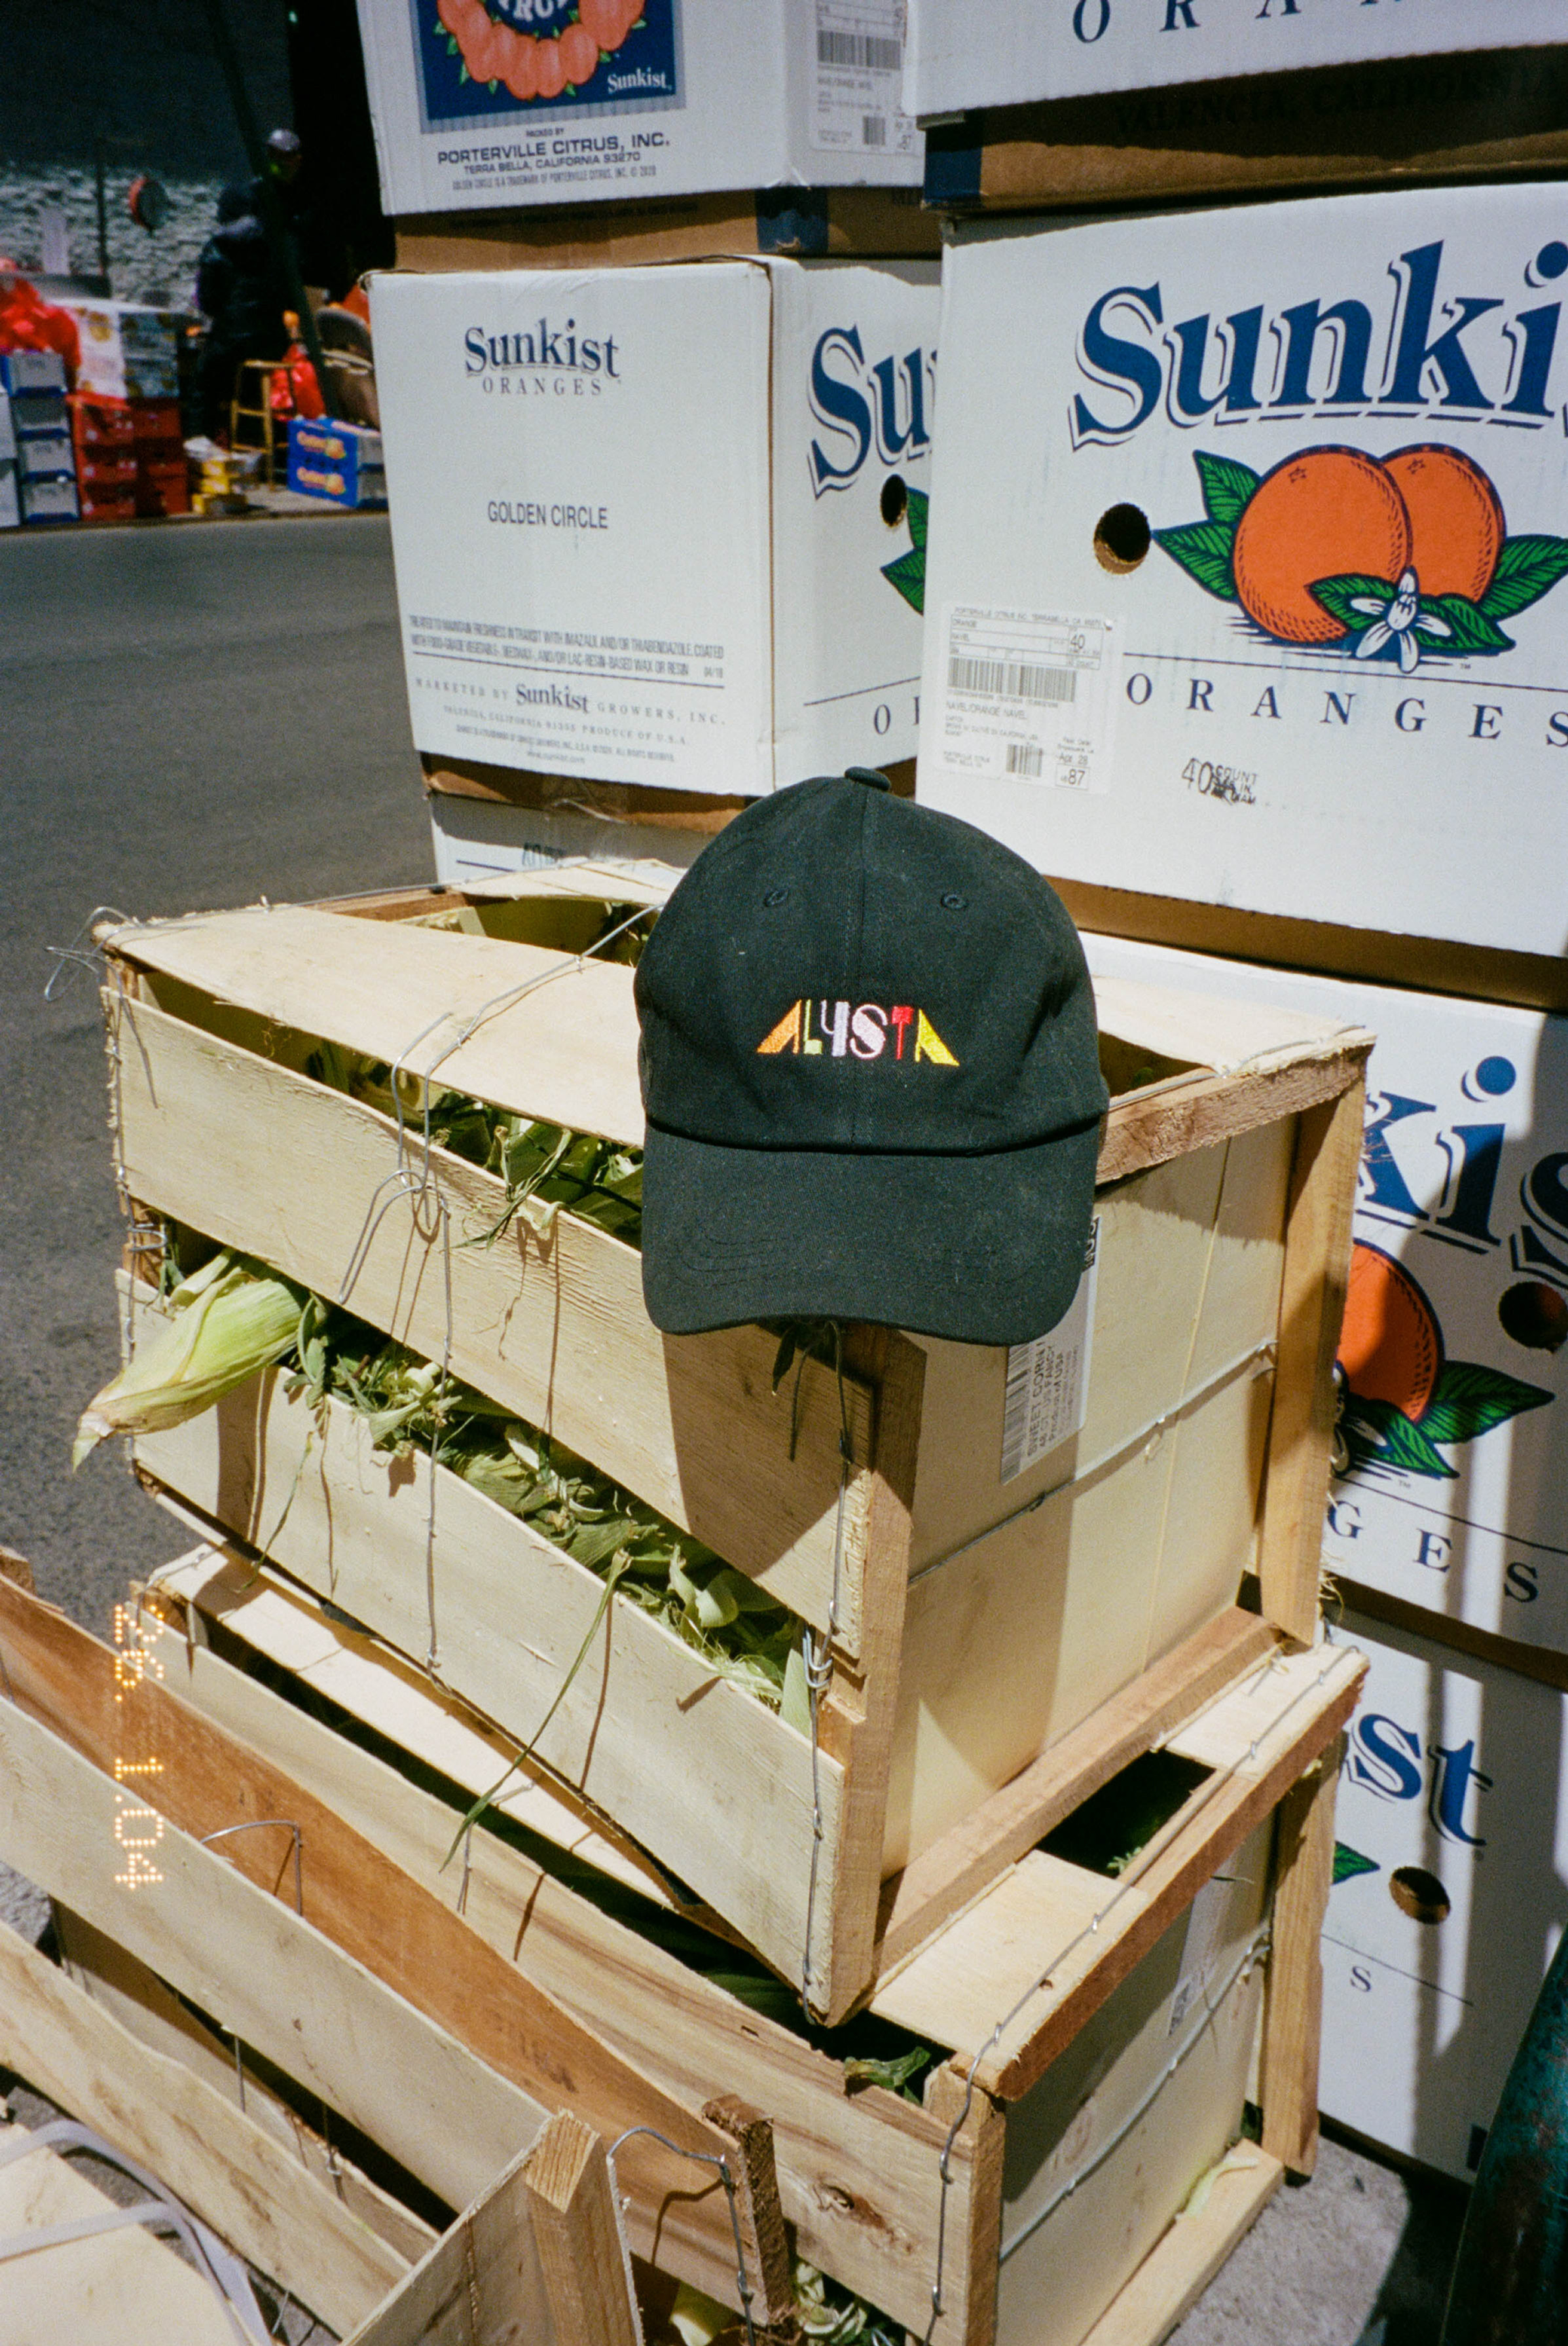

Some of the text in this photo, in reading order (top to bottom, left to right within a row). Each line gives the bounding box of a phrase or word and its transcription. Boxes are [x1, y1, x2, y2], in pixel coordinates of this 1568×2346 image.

[607, 67, 667, 94] Sunkist
[438, 132, 669, 164] PORTERVILLE CITRUS, INC.
[464, 152, 640, 174] TERRA BELLA, CALIFORNIA 93270
[464, 318, 620, 378] Sunkist
[1068, 239, 1568, 452] Sunki
[483, 375, 602, 395] ORANGES
[809, 322, 938, 500] Su
[488, 500, 608, 530] GOLDEN CIRCLE
[1069, 632, 1085, 650] 40
[516, 683, 589, 714] Sunkist
[597, 701, 680, 722] GROWERS,
[690, 712, 725, 725] INC.
[873, 696, 921, 735] O
[1126, 673, 1568, 748] ORANGES
[638, 731, 651, 741] OF
[1067, 767, 1085, 786] 87
[1182, 757, 1213, 795] 40
[1032, 1349, 1046, 1398] CORN
